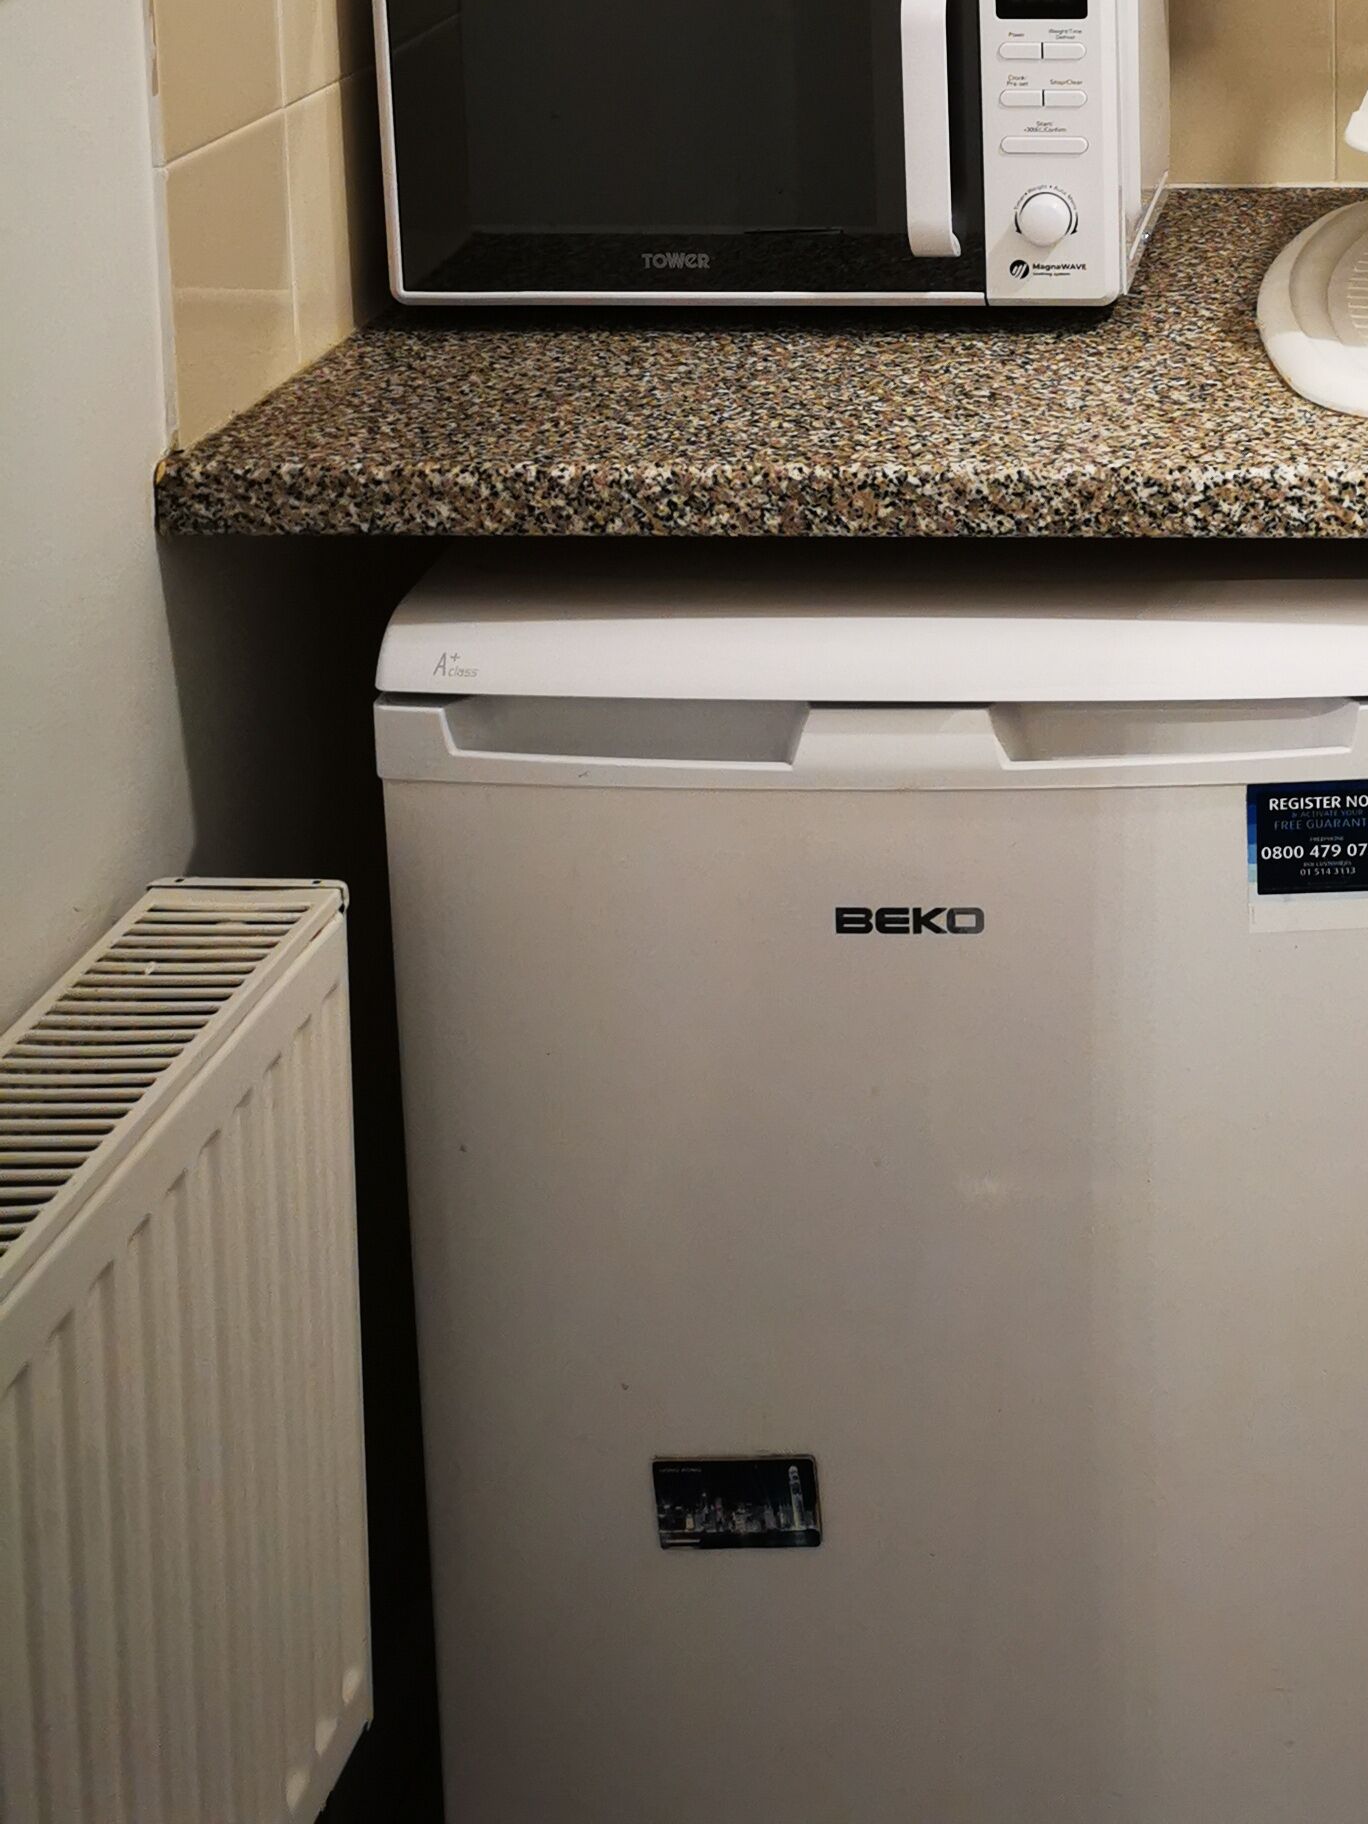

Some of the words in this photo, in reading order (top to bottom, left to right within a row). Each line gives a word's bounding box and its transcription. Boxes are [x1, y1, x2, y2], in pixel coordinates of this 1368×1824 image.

[1032, 263, 1087, 271] MagnaWAVE
[1269, 796, 1341, 811] REGISTER
[1274, 819, 1302, 831] FREE
[1260, 845, 1304, 860] 0800
[1309, 843, 1342, 858] 479
[1314, 867, 1331, 875] 514
[1333, 866, 1357, 875] 3113
[835, 907, 985, 934] BEKO
